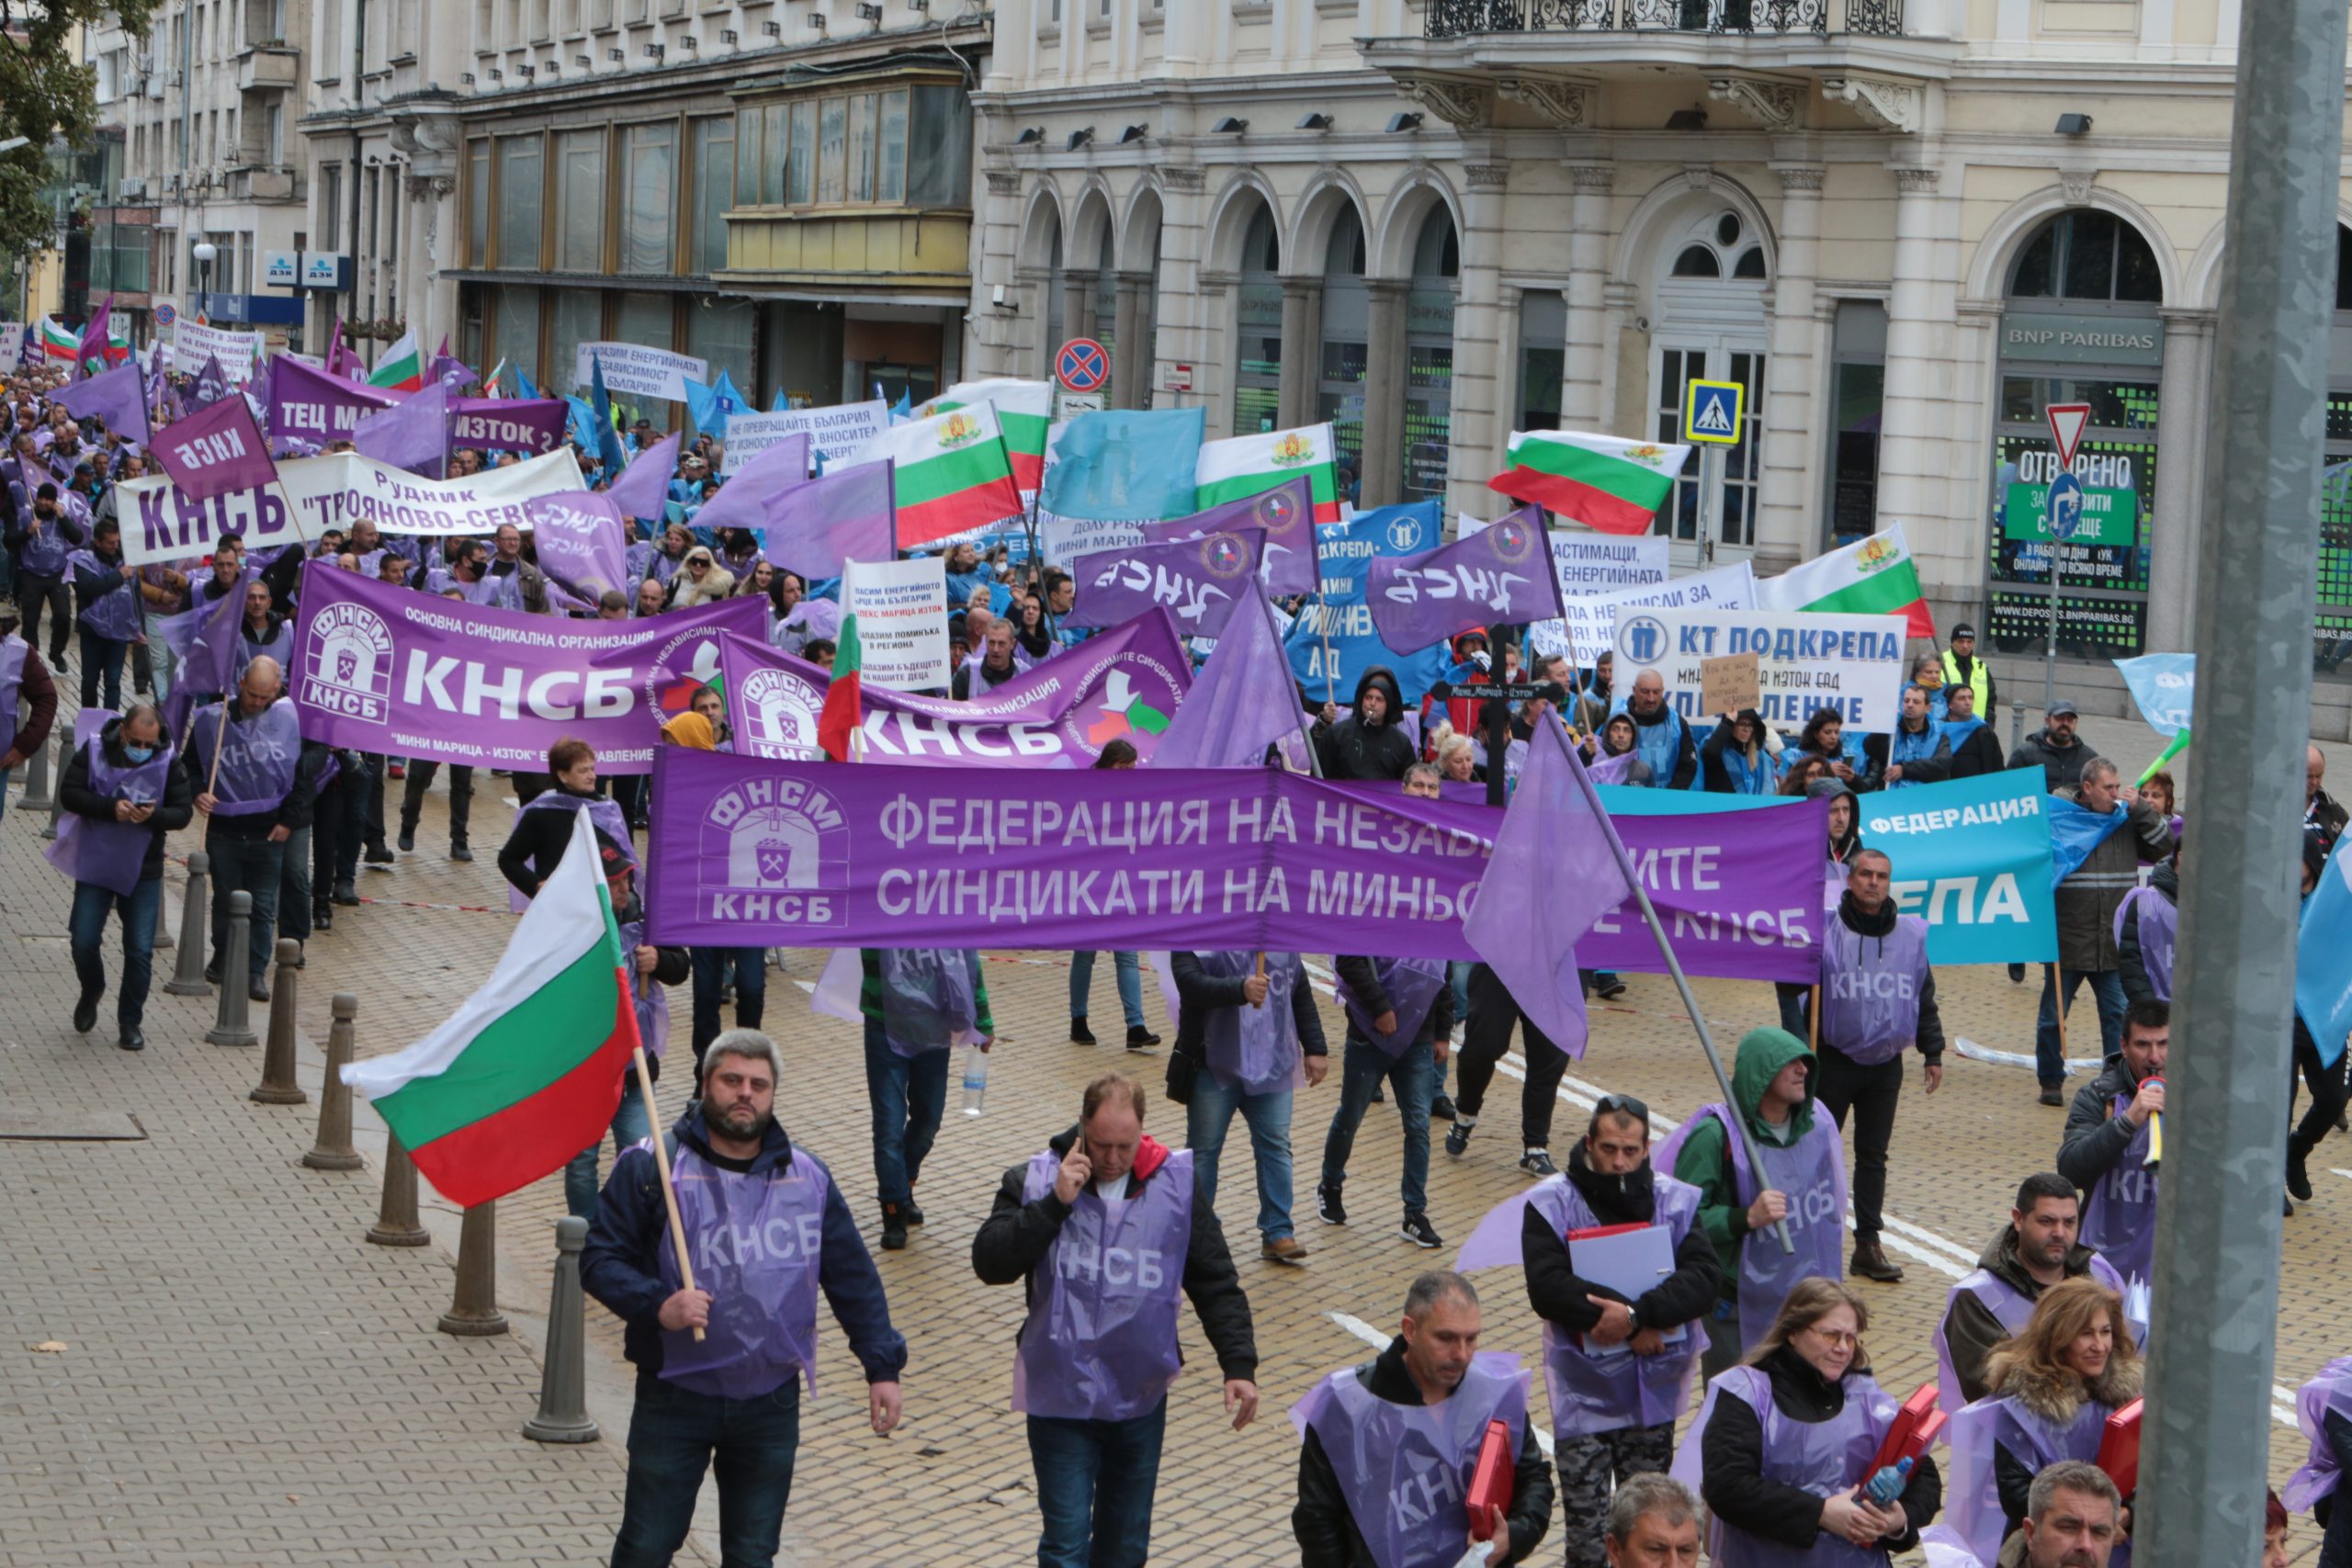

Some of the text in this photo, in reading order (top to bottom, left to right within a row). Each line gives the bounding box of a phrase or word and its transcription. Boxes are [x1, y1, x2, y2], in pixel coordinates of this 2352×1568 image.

[226, 334, 255, 344] ЗАЩИТ
[2009, 330, 2154, 349] BNP PARIBAS
[601, 360, 669, 381] ЗАВИСИМОСТ
[630, 350, 698, 373] ЕНЕРГИЙНАТА
[606, 376, 662, 395] БЪЛГАРИЯ!
[282, 401, 326, 434] ТЕЦ
[730, 411, 872, 434] НЕ ПРЕВРЪЩАЙТЕ БЪЛГАРИЯ
[455, 415, 534, 445] ИЗТОК
[725, 440, 735, 451] ОТ
[820, 426, 878, 444] ВНОСИТЕЛ
[2020, 450, 2132, 487] ОТВРЕНО
[1072, 520, 1106, 536] ДОЛУ
[1317, 541, 1374, 560] ДКРЕПА
[1554, 544, 1641, 565] АСТИМАЩИ,
[2070, 547, 2089, 560] ДНИ
[1563, 565, 1664, 584] ЕНЕРГИЙНАТА
[2013, 557, 2048, 571] ОНЛАЙН
[2068, 560, 2095, 575] ВСЯКО
[2096, 564, 2123, 578] ВРЕМЕ
[855, 581, 941, 595] ПАСИМ ЕНЕРГИЙНОТО
[888, 593, 932, 605] БЪЛГАРИЯ
[1690, 584, 1713, 603] ЗА
[881, 607, 916, 618] МАРИЦА
[918, 604, 943, 615] ИЗТОК
[312, 604, 391, 653] ФНСМ
[405, 606, 656, 651] ОСНОВНА СИНДИКАЛНА ОРГАНИЗАЦИЯ
[860, 627, 940, 640] АПАЗИМ ПОМИНЪКА
[877, 640, 914, 650] РЕГИОНА
[1679, 625, 1901, 663] КТ ПОДКРЕПА
[873, 673, 905, 682] НАШИТЕ
[908, 671, 929, 682] ДЕЦА
[897, 660, 942, 671] БЪДЕЩЕТО
[403, 648, 636, 722] КНСБ
[1773, 671, 1811, 688] ИЗТОК
[1815, 672, 1840, 691] ЕАД
[309, 682, 379, 720] КНСБ
[645, 680, 670, 727] ДЕРАЦИЯ
[968, 676, 1062, 716] ОРГАНИЗАЦИЯ
[850, 708, 1063, 757] КНСБ
[434, 739, 484, 760] МАРИЦА
[597, 749, 655, 762] АВЛЕНИЕ
[708, 774, 844, 831] ФНСМ
[878, 792, 1210, 855] ФЕДЕРАЦИЯ
[1229, 795, 1297, 844] НА
[1869, 795, 2040, 836] ФЕДЕРАЦИЯ
[876, 867, 1204, 924] СИНДИКАТИ
[1224, 866, 1291, 914] НА
[712, 891, 834, 923] КНСБ
[1831, 971, 1914, 1000] КНСБ
[700, 1212, 822, 1270] КНСБ
